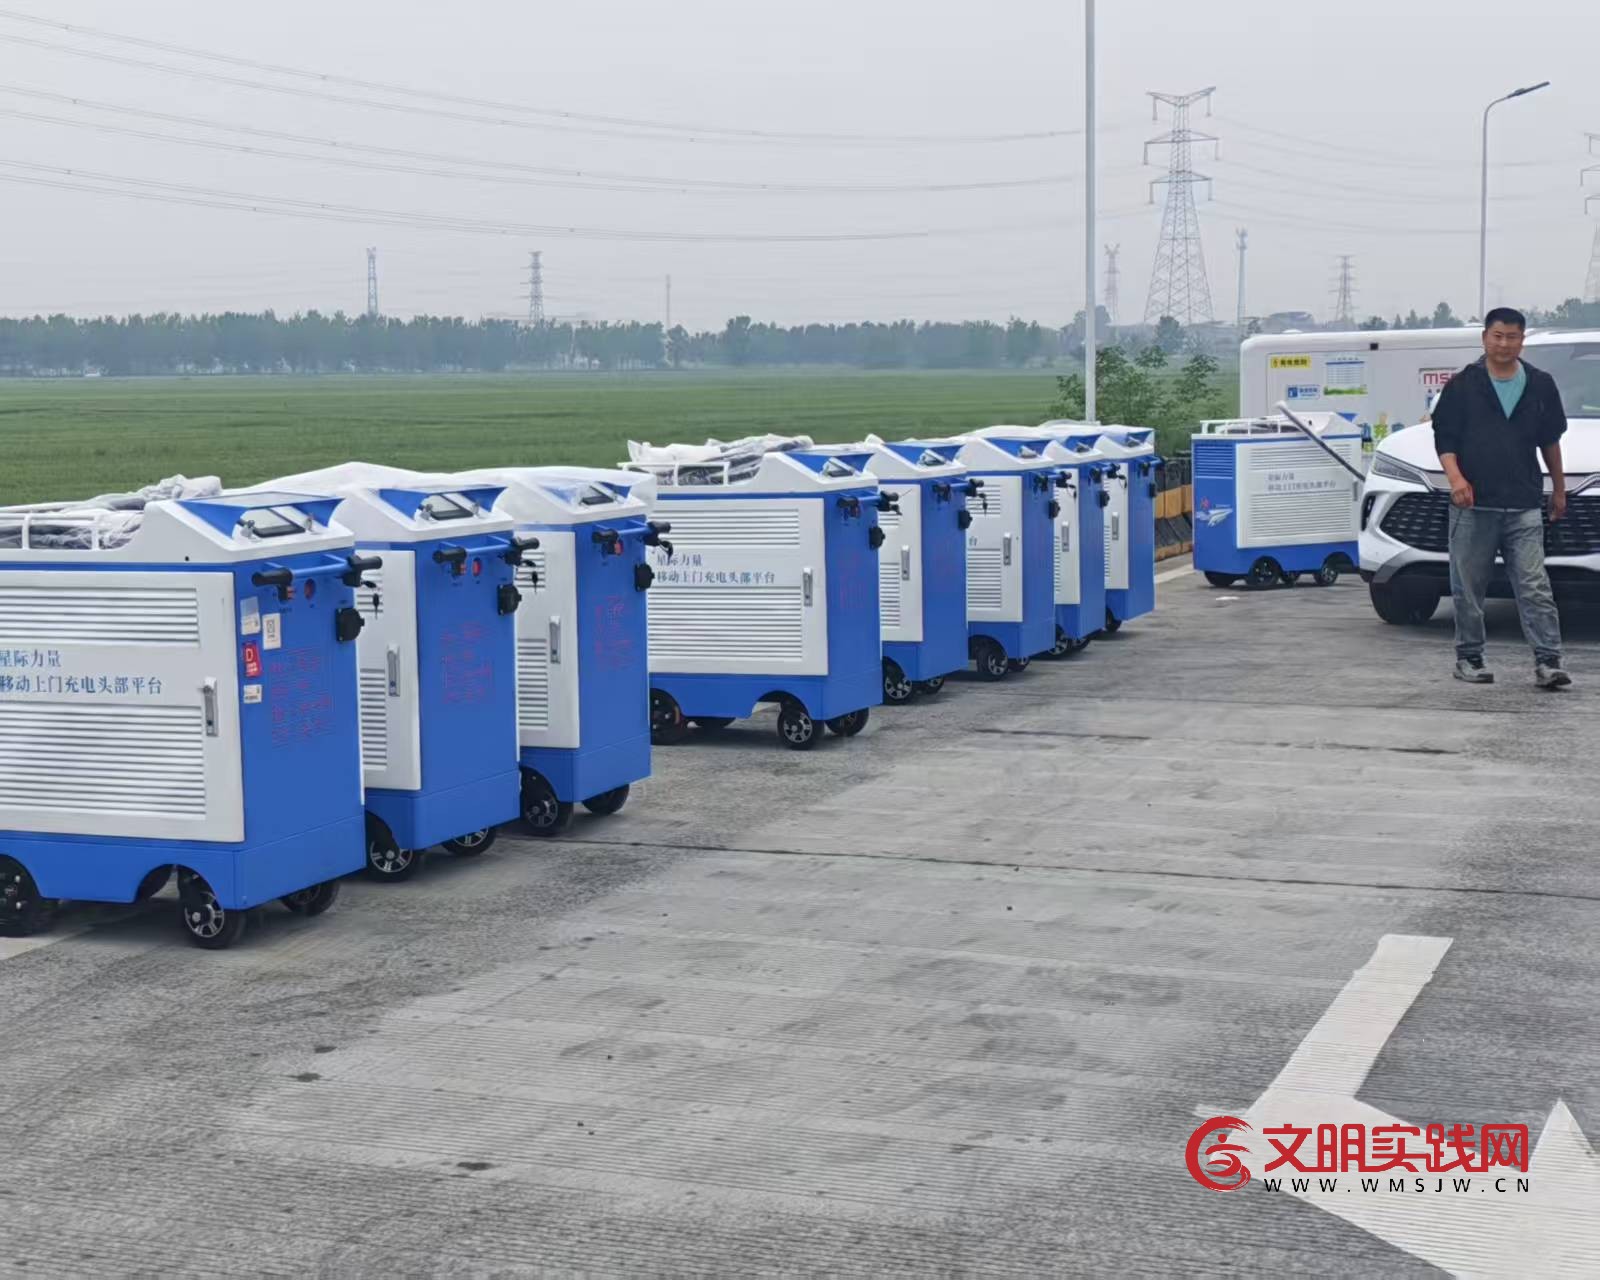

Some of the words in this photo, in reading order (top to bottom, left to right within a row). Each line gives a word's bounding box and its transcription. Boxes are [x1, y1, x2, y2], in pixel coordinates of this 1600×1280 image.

[657, 570, 775, 584] 移动上门充电头部平台
[0, 649, 62, 668] 星际力量
[0, 675, 162, 695] 移动上门充电头部平台
